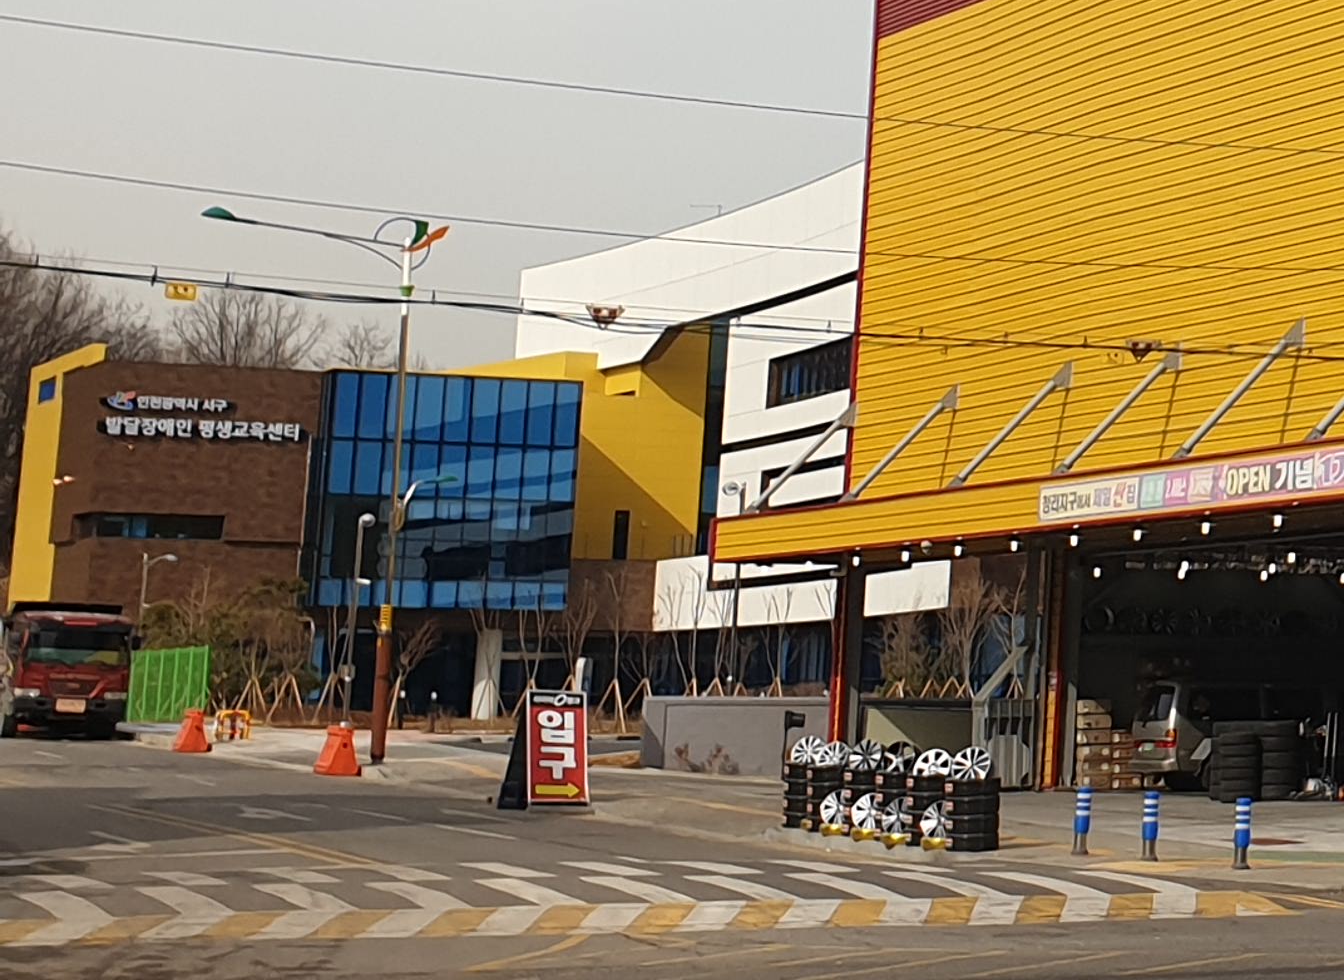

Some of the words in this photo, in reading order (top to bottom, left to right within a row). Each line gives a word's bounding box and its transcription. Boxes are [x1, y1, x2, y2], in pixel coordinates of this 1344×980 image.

[202, 398, 228, 412] 서구
[105, 416, 193, 438] 발달장애인
[198, 419, 300, 442] 평생교육센터
[1226, 463, 1271, 496] OPEN
[1274, 457, 1314, 490] 기념
[537, 710, 577, 780] 입구
